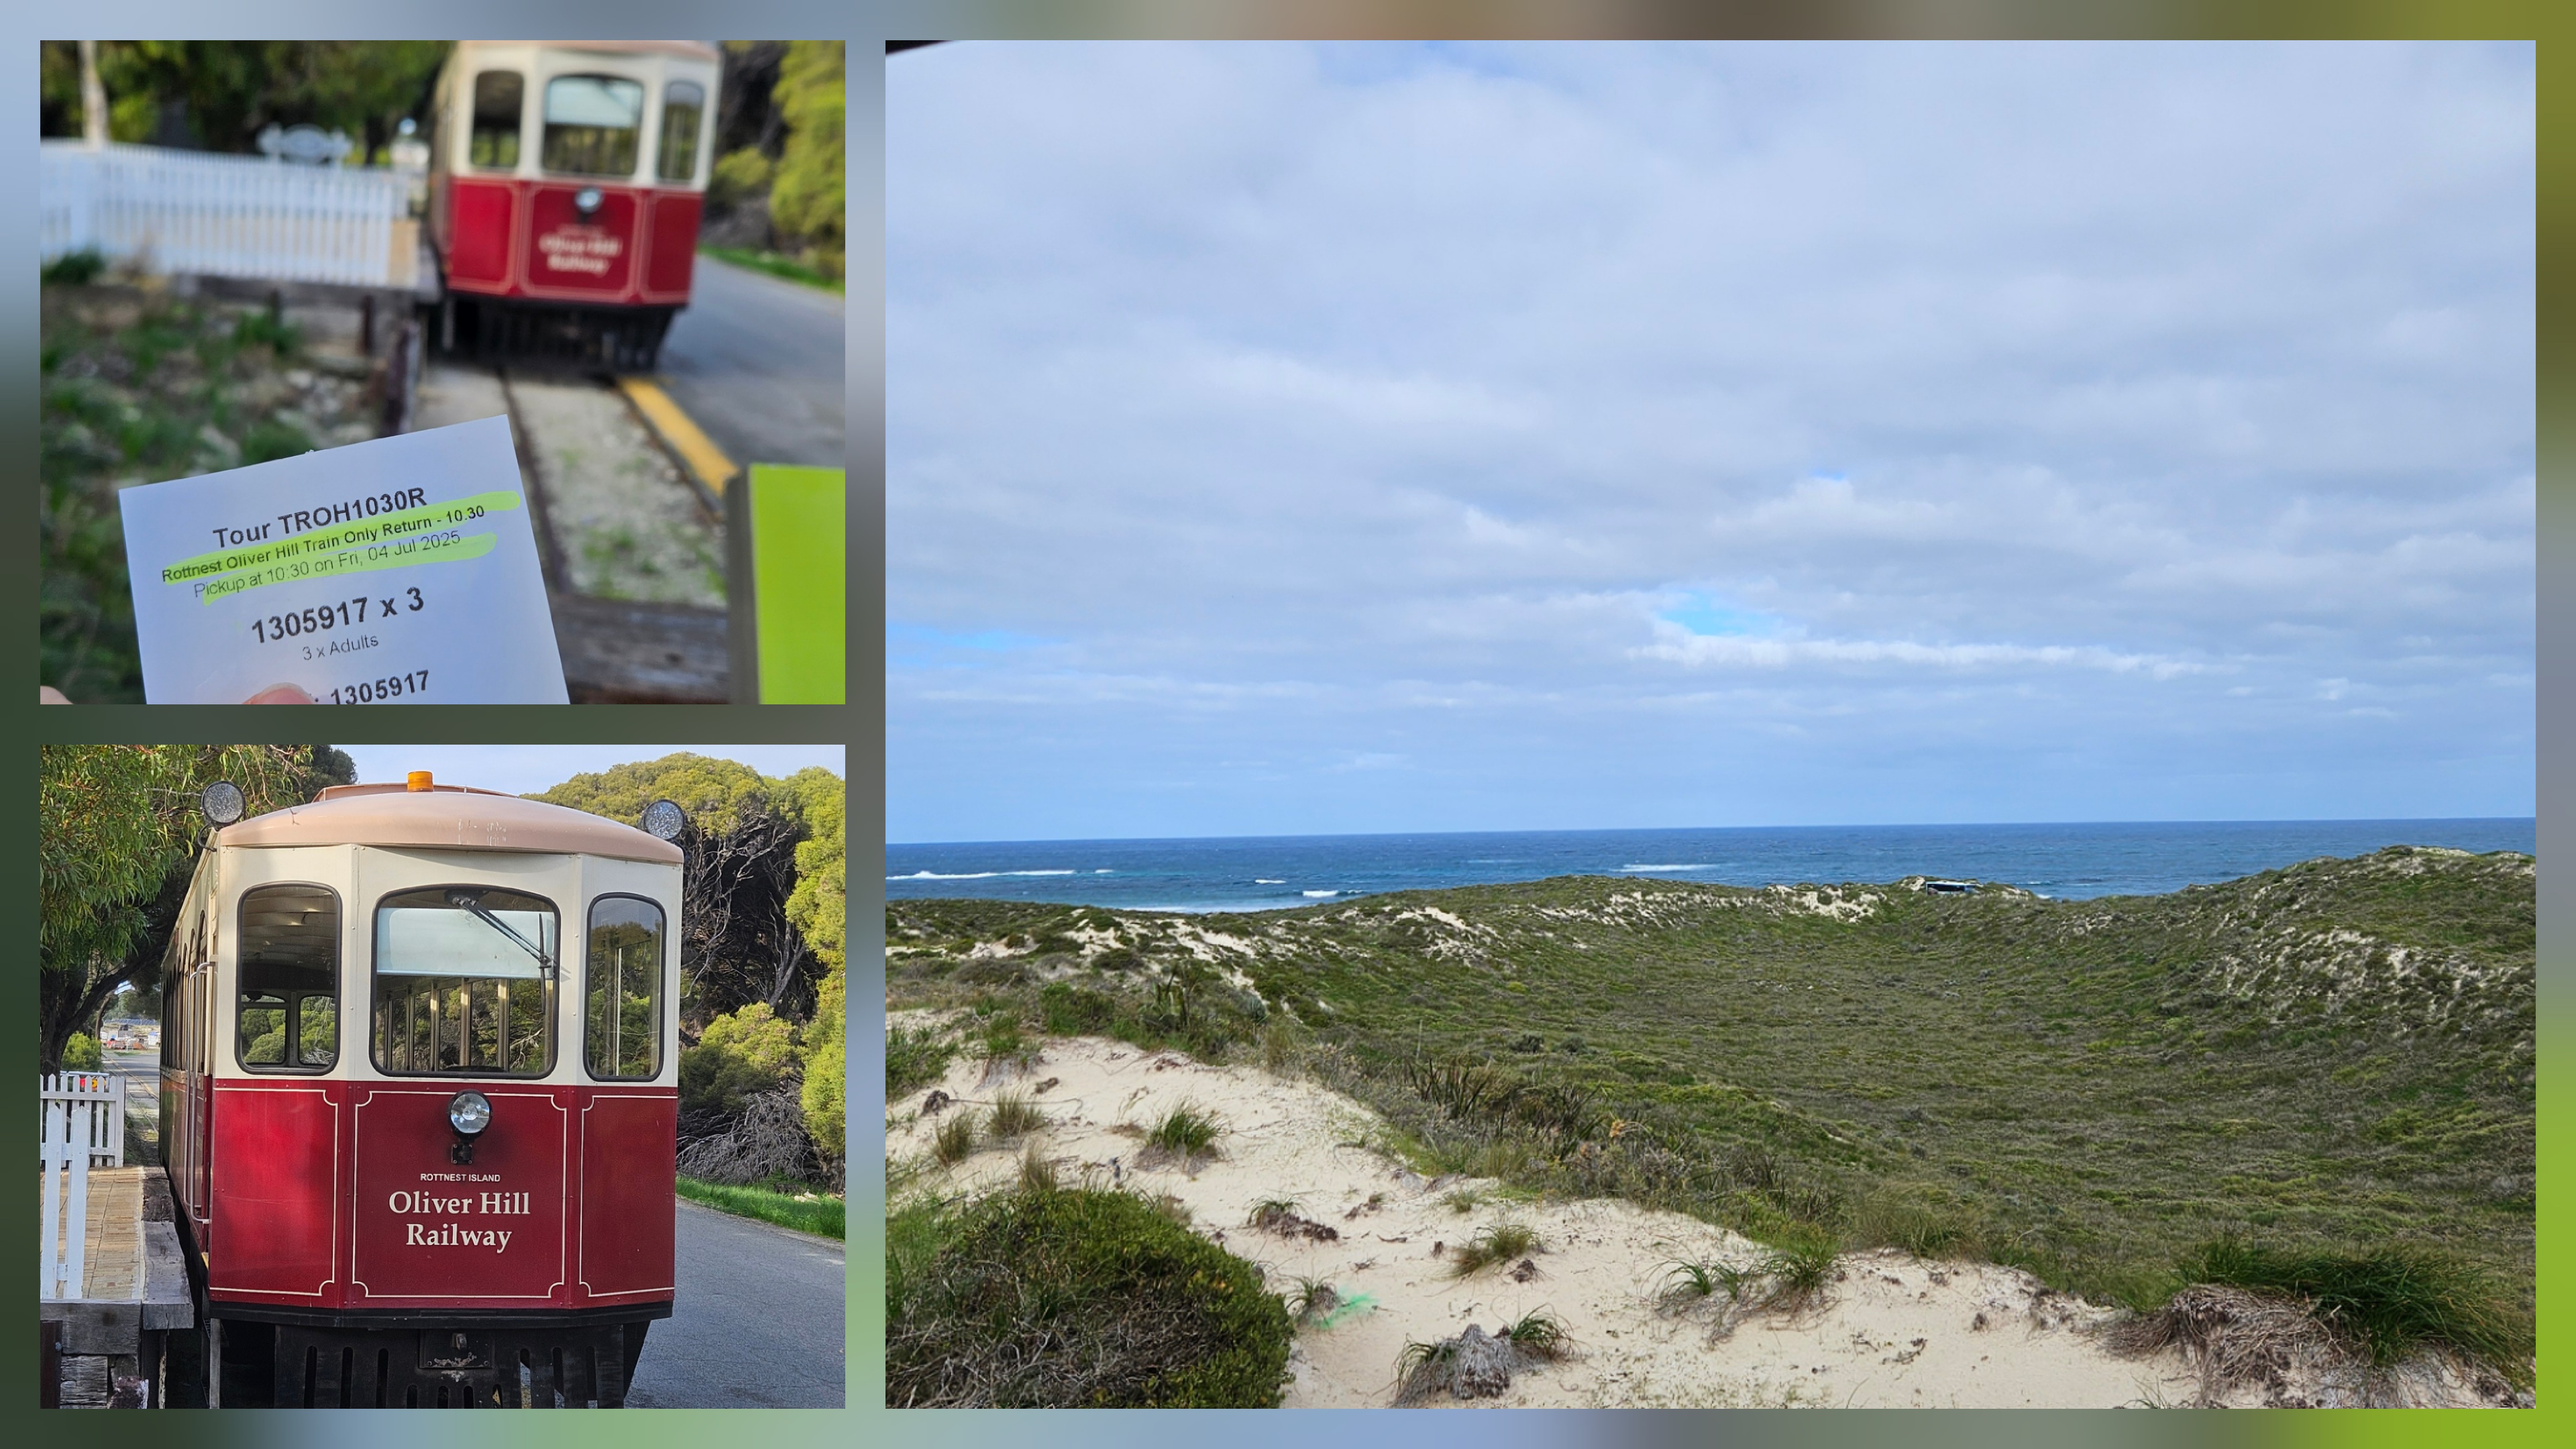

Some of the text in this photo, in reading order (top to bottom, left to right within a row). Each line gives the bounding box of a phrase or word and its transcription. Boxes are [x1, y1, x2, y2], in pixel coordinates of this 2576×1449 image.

[213, 487, 427, 548] Tour TROH1030R
[162, 559, 222, 582] Rottnest
[226, 551, 271, 569] Oliver
[276, 543, 299, 559] Hill
[303, 536, 339, 553] Train
[344, 527, 377, 543] Only
[382, 518, 432, 537] Return
[446, 505, 484, 524] 10.30
[194, 531, 461, 597] Pickup at 10:30 on Fri, 04 Jul 2025
[252, 586, 424, 643] 1305917 x 3
[302, 634, 379, 661] 3 x Adults
[331, 669, 429, 704] 1305917
[420, 1173, 500, 1182] ROTTNEST ISLAND
[388, 1191, 531, 1214] Oliver Hill
[406, 1223, 512, 1253] Railway
